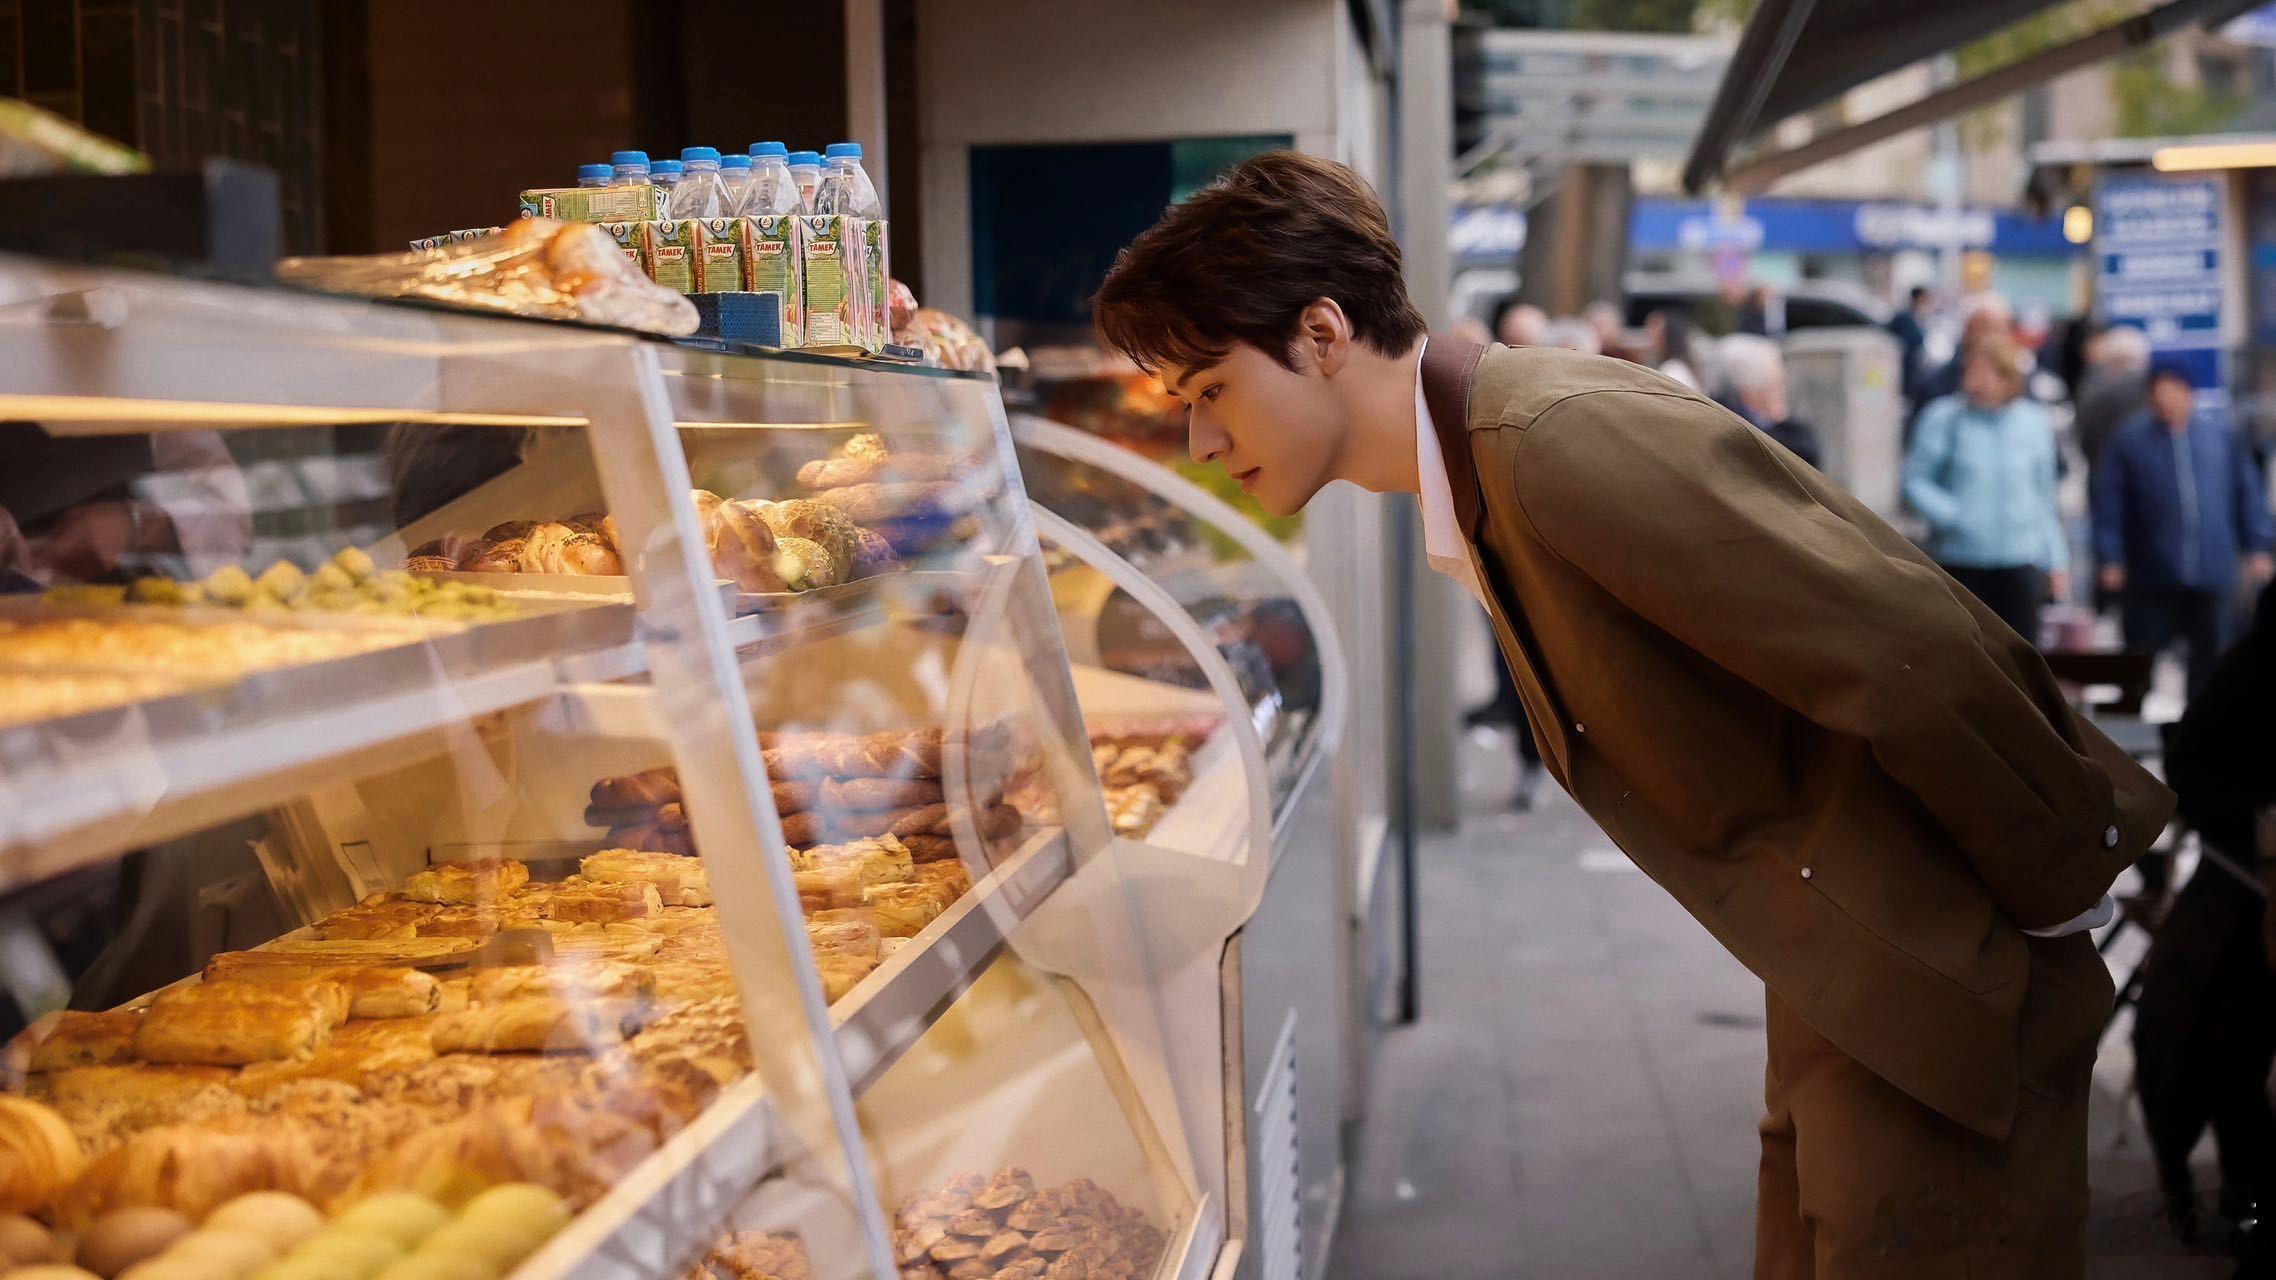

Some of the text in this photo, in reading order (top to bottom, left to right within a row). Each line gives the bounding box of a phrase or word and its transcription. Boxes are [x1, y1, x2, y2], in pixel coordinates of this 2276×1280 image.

[707, 245, 733, 254] TAMEK
[756, 243, 782, 252] TAMEK
[809, 243, 834, 252] TAMEK
[657, 248, 683, 257] TAMEK
